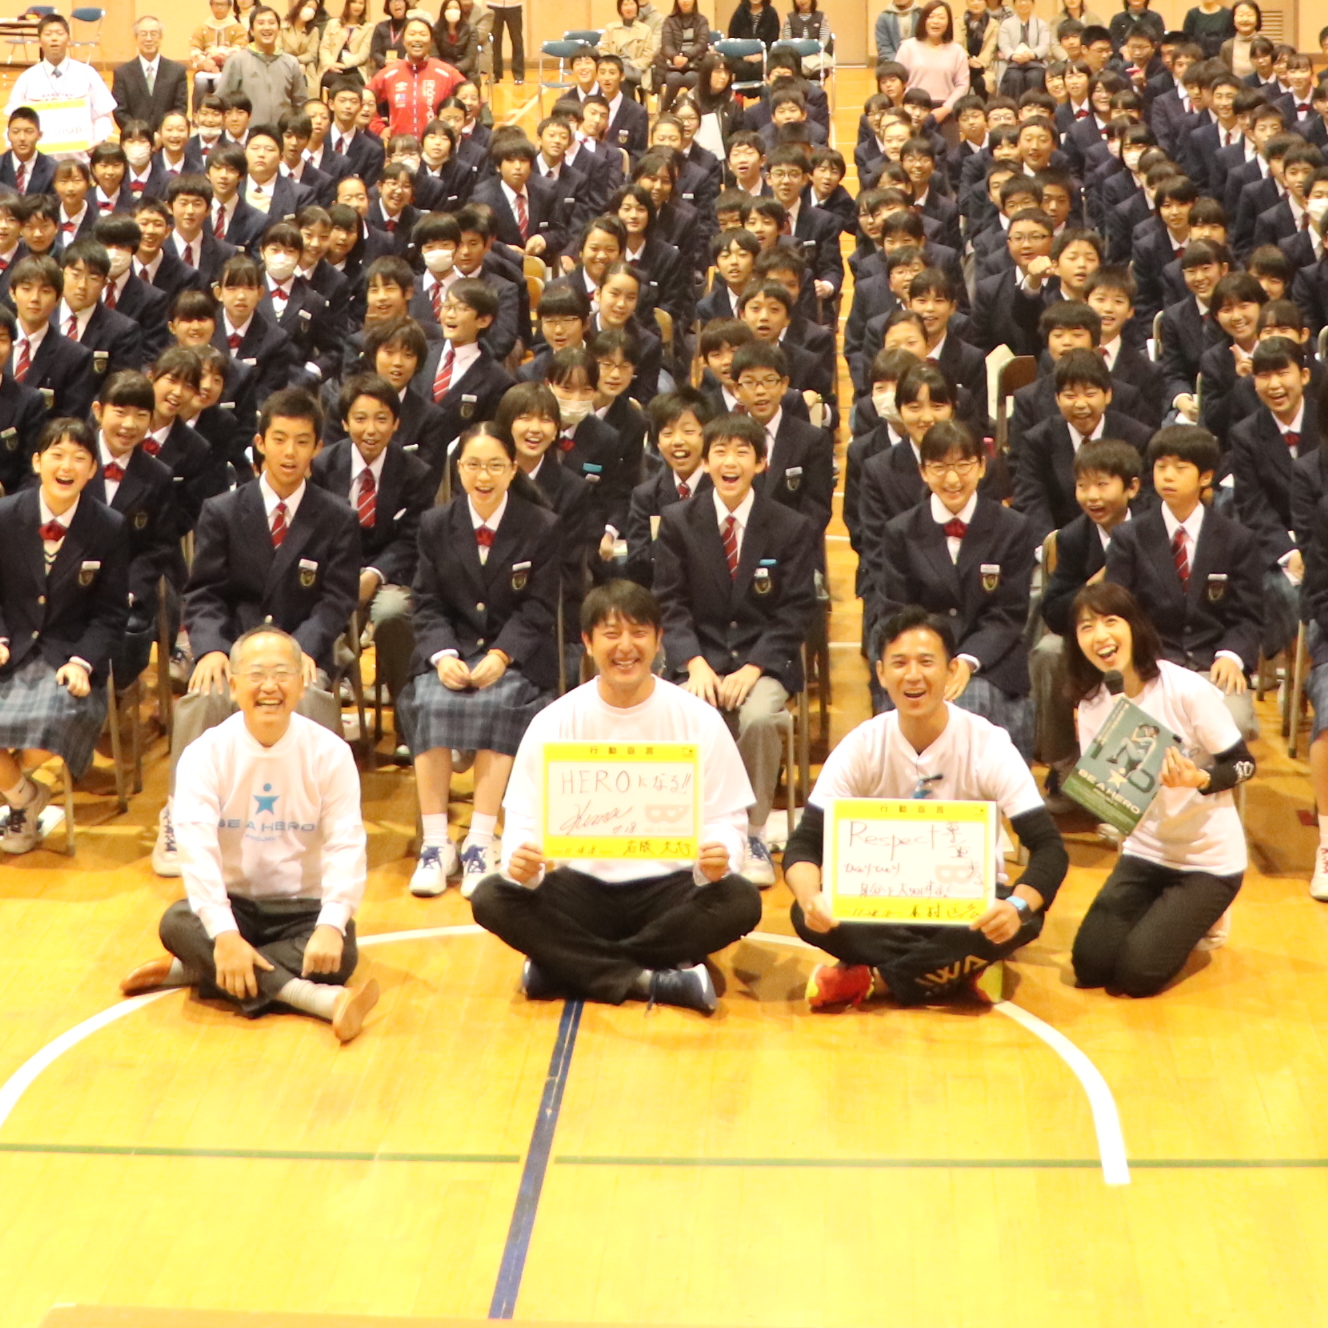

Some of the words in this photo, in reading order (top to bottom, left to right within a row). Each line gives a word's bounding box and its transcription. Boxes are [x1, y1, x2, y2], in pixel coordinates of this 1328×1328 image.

[1106, 788, 1141, 815] HERO
[245, 821, 257, 831] A
[261, 821, 315, 832] HERO
[849, 820, 940, 862] Respect
